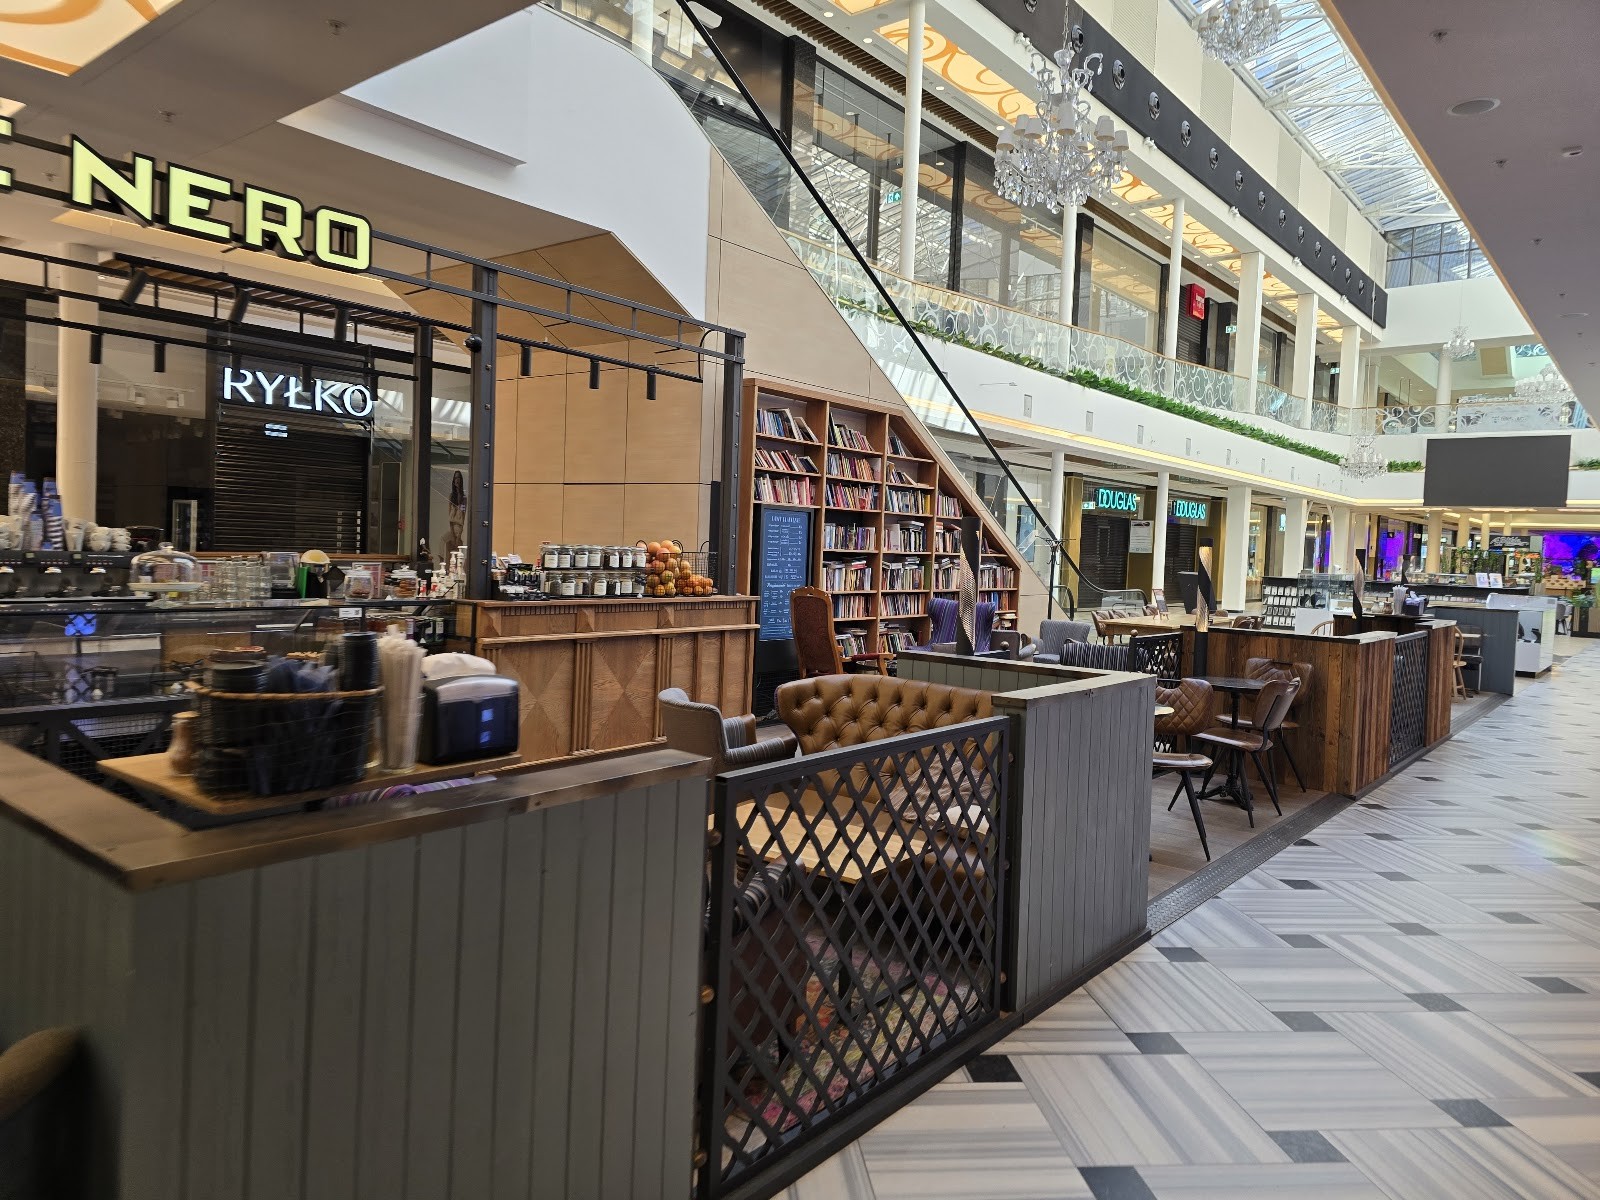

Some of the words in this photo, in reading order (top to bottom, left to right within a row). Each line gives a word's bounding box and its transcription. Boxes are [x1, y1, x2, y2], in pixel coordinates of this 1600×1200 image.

[71, 135, 372, 271] NERO
[223, 367, 373, 417] RYŁKO
[1099, 488, 1137, 511] DOUGLAS
[1176, 501, 1206, 519] DOUGLAS
